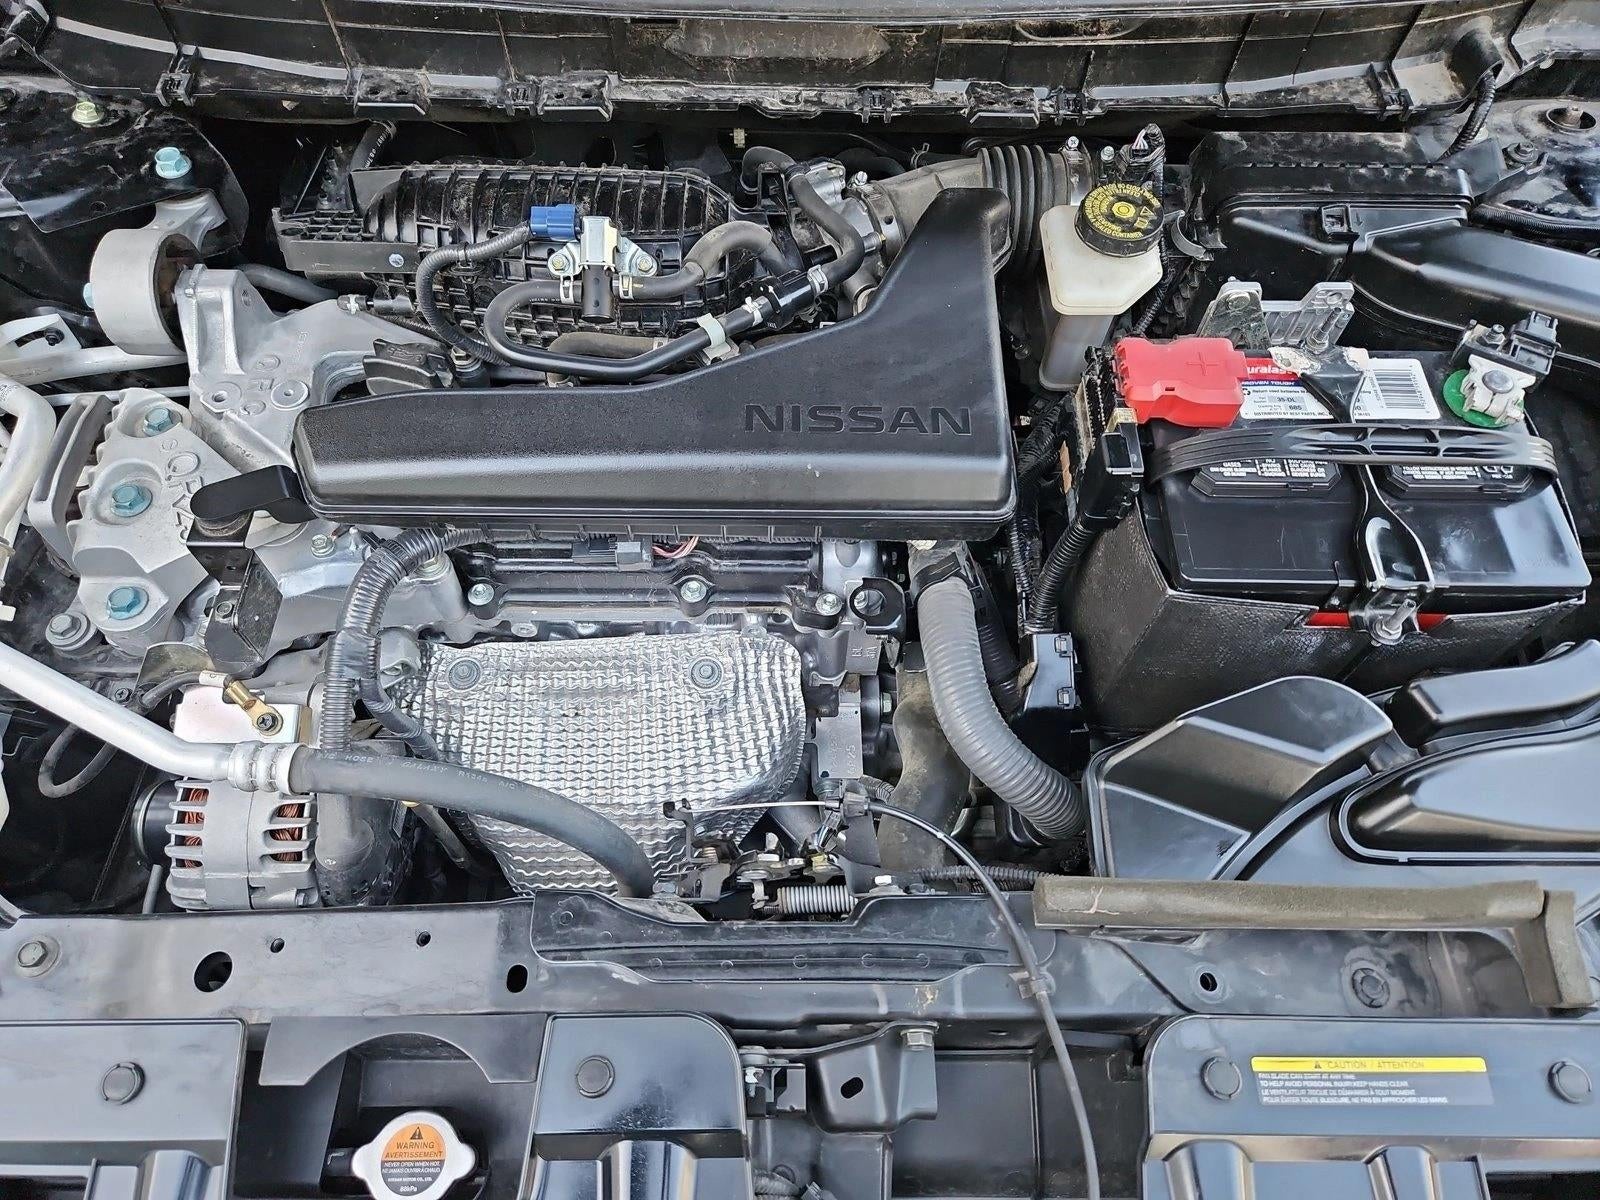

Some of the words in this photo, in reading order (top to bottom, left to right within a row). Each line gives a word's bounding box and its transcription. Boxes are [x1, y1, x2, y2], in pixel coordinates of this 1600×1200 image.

[1247, 365, 1294, 374] uralas
[744, 403, 972, 436] NISSAN
[344, 754, 374, 763] HOSE
[400, 761, 450, 774] GALAXY
[1327, 1061, 1366, 1069] CAUTION
[1378, 1060, 1424, 1069] ATTENTION
[396, 1141, 435, 1150] WARNING
